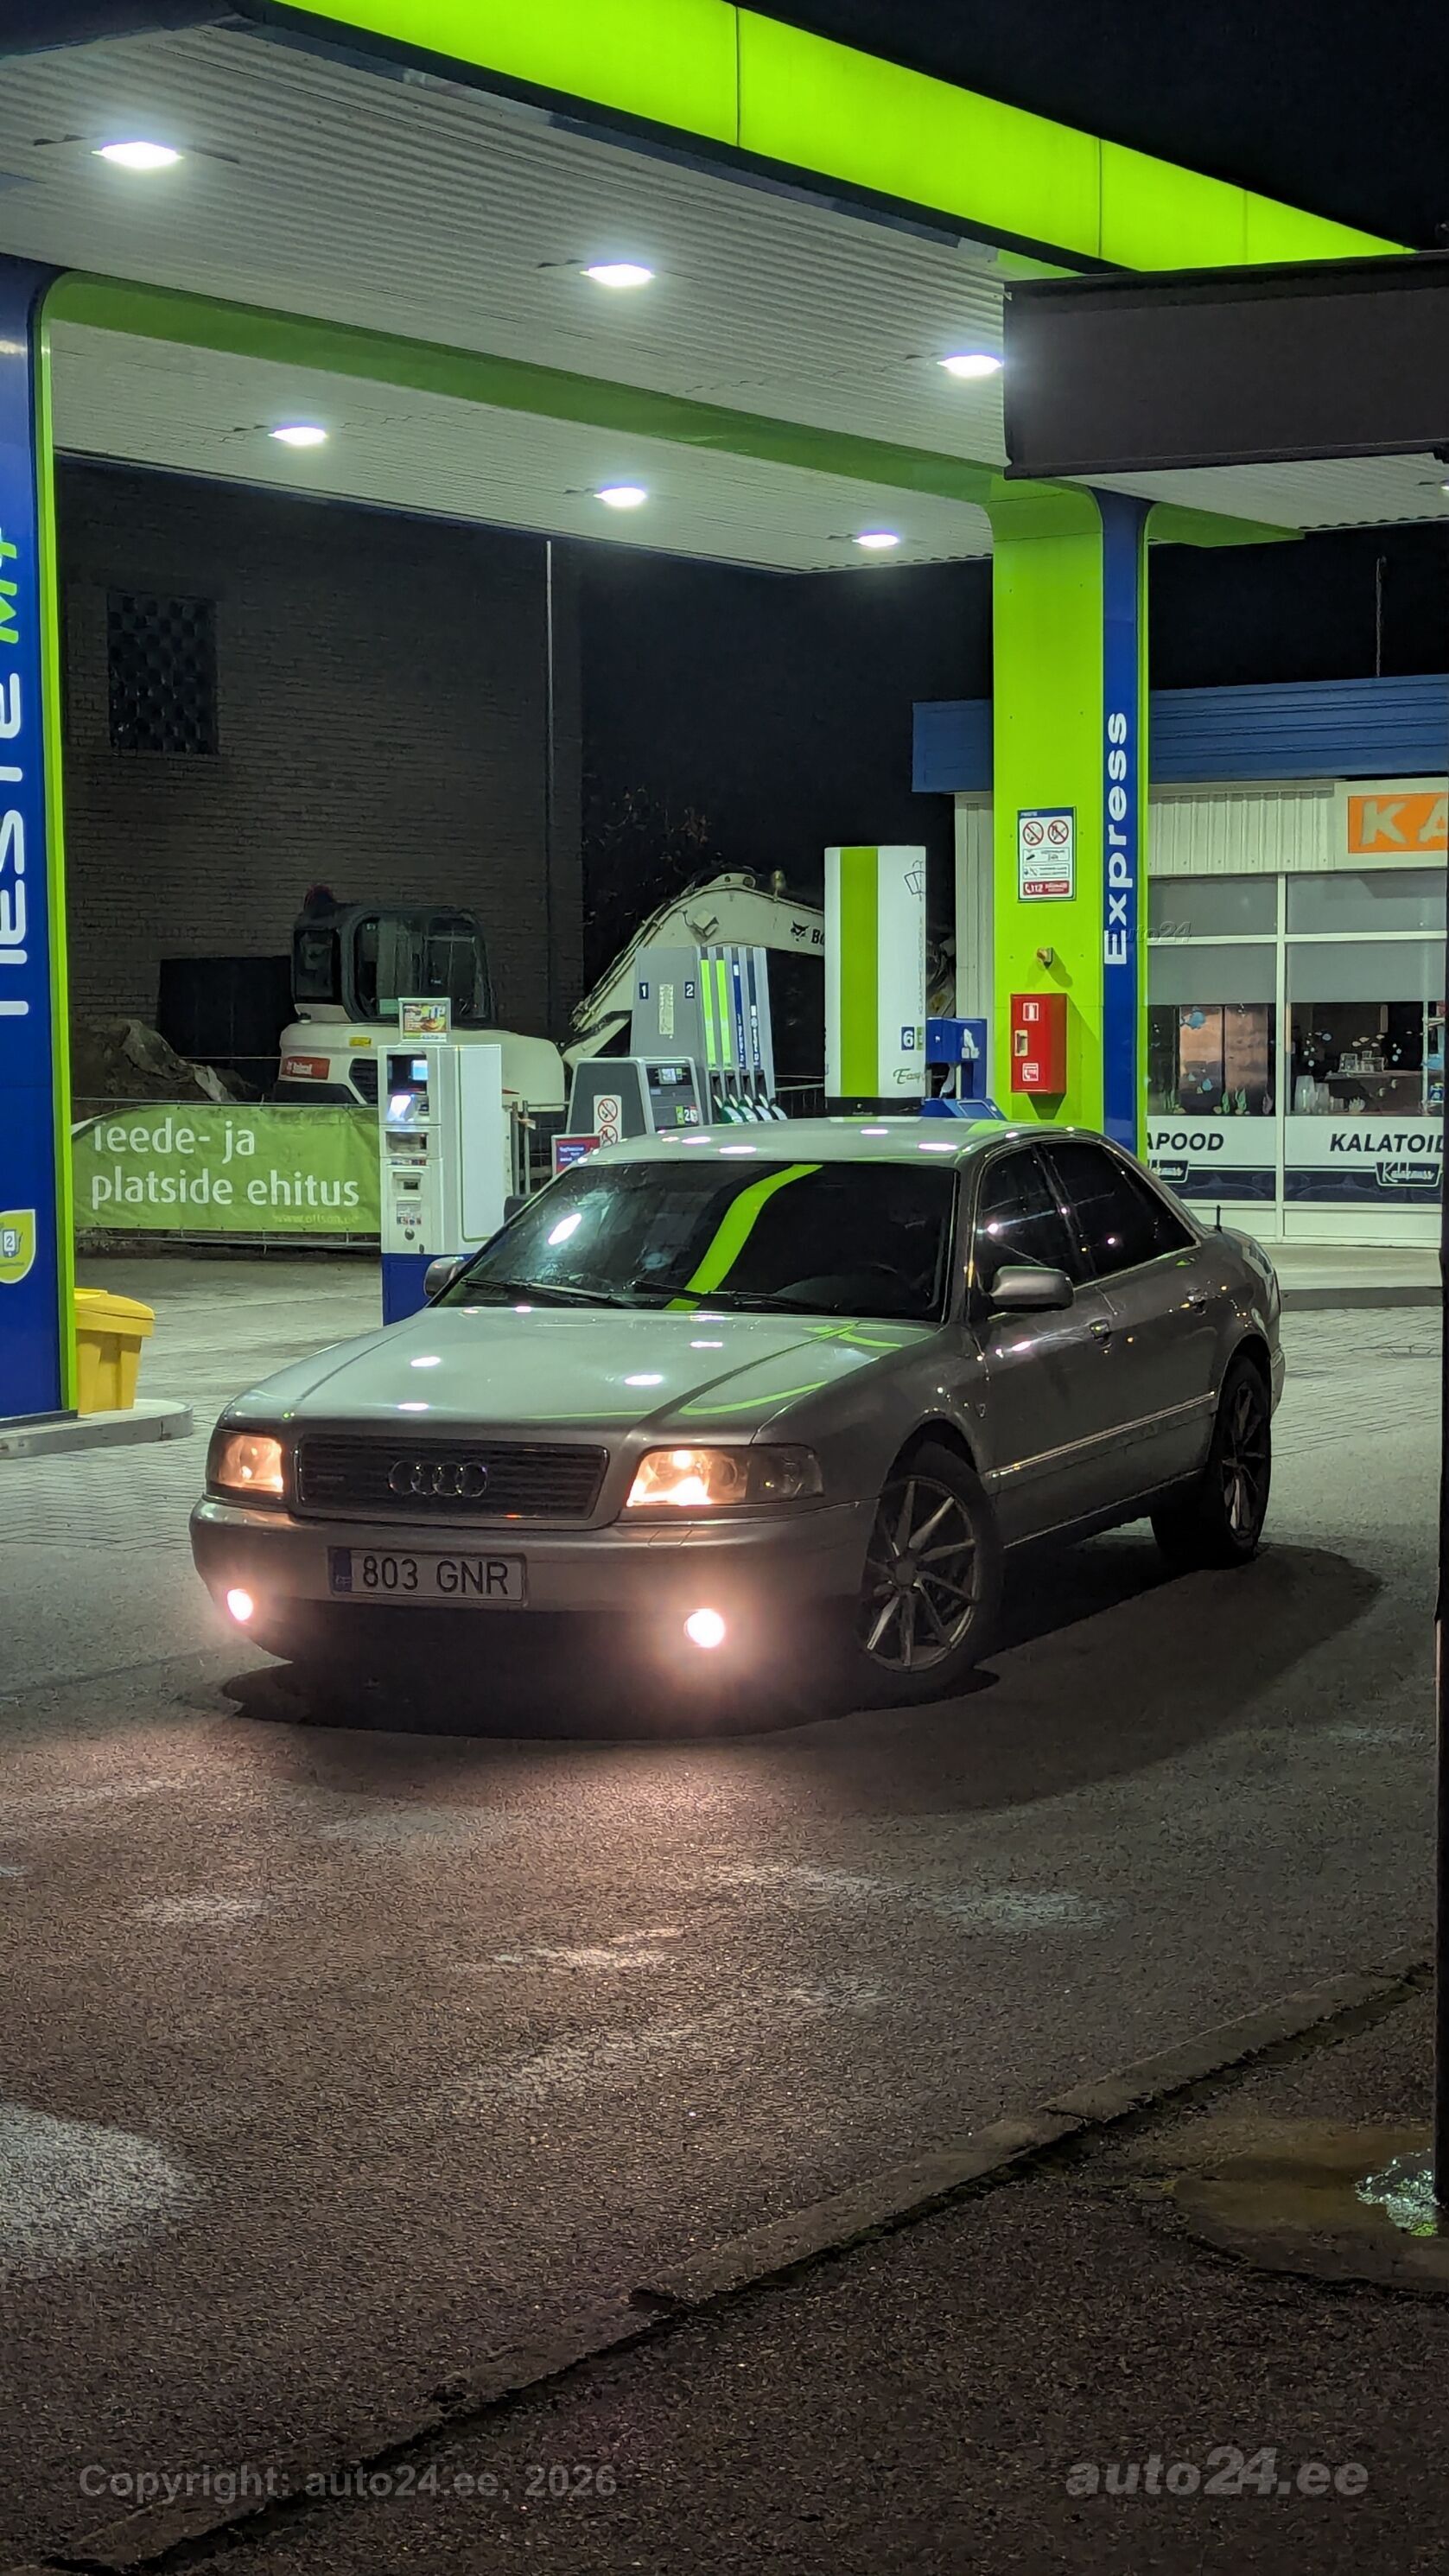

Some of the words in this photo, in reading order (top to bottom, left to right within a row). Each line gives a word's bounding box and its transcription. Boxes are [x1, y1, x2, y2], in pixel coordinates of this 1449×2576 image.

[1104, 713, 1132, 964] Express
[1362, 798, 1447, 845] KA
[686, 984, 694, 996] 2
[903, 1030, 913, 1047] 6
[222, 1121, 255, 1164] ja
[92, 1166, 232, 1210] platside
[247, 1170, 359, 1205] ehitus
[363, 1555, 418, 1590] 803
[436, 1560, 508, 1593] GNR
